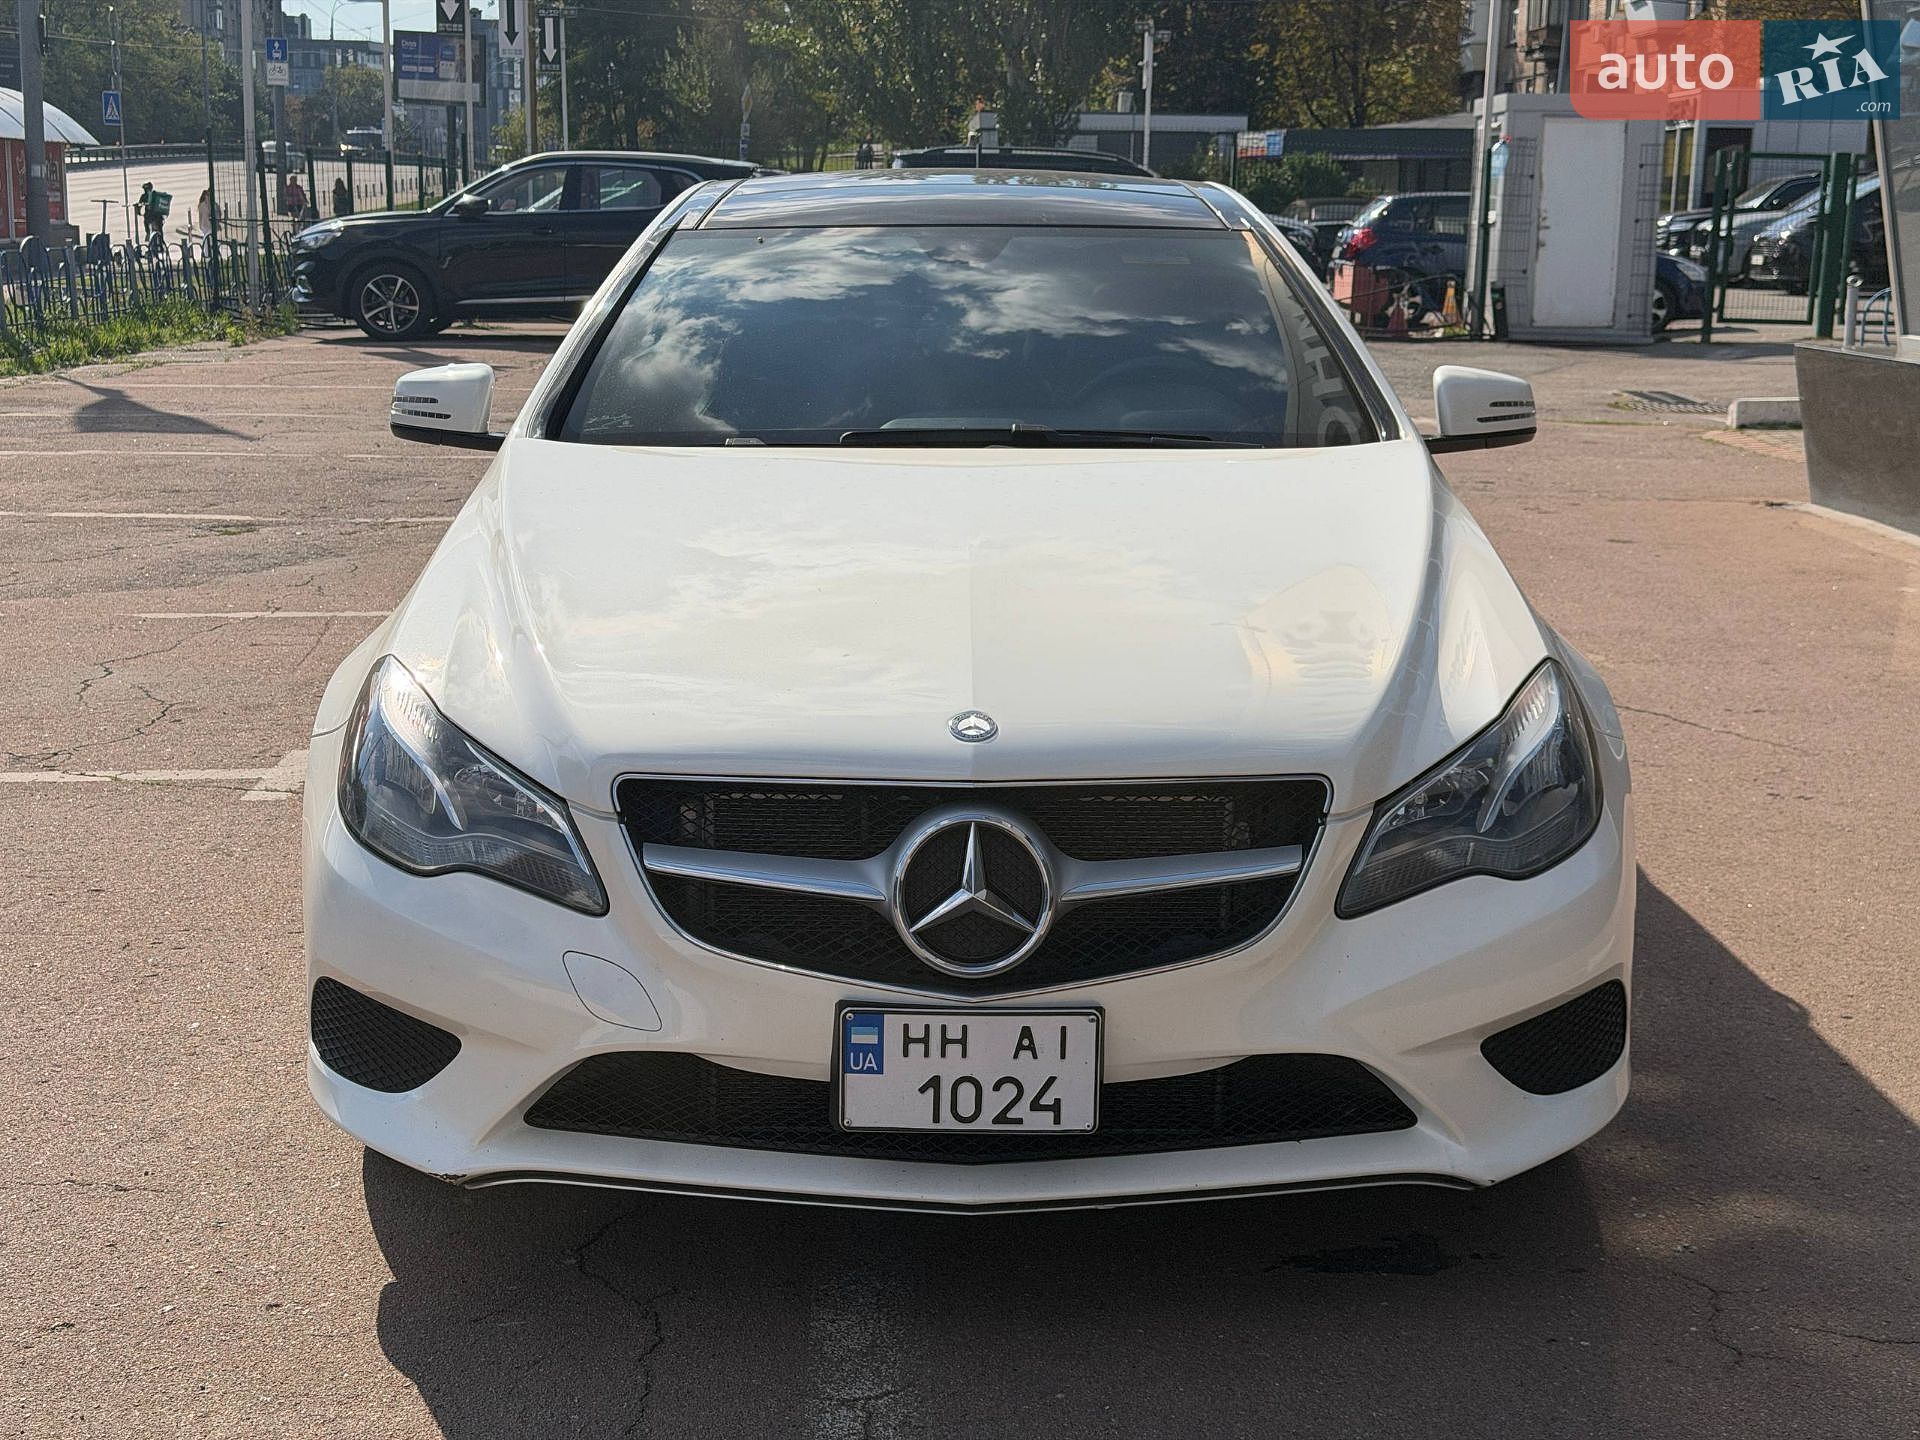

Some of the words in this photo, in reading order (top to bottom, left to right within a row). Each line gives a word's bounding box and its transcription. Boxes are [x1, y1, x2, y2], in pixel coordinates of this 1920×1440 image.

[903, 1023, 968, 1058] HH
[1012, 1025, 1067, 1060] AI
[850, 1052, 878, 1071] UA
[917, 1074, 1062, 1126] 1024
